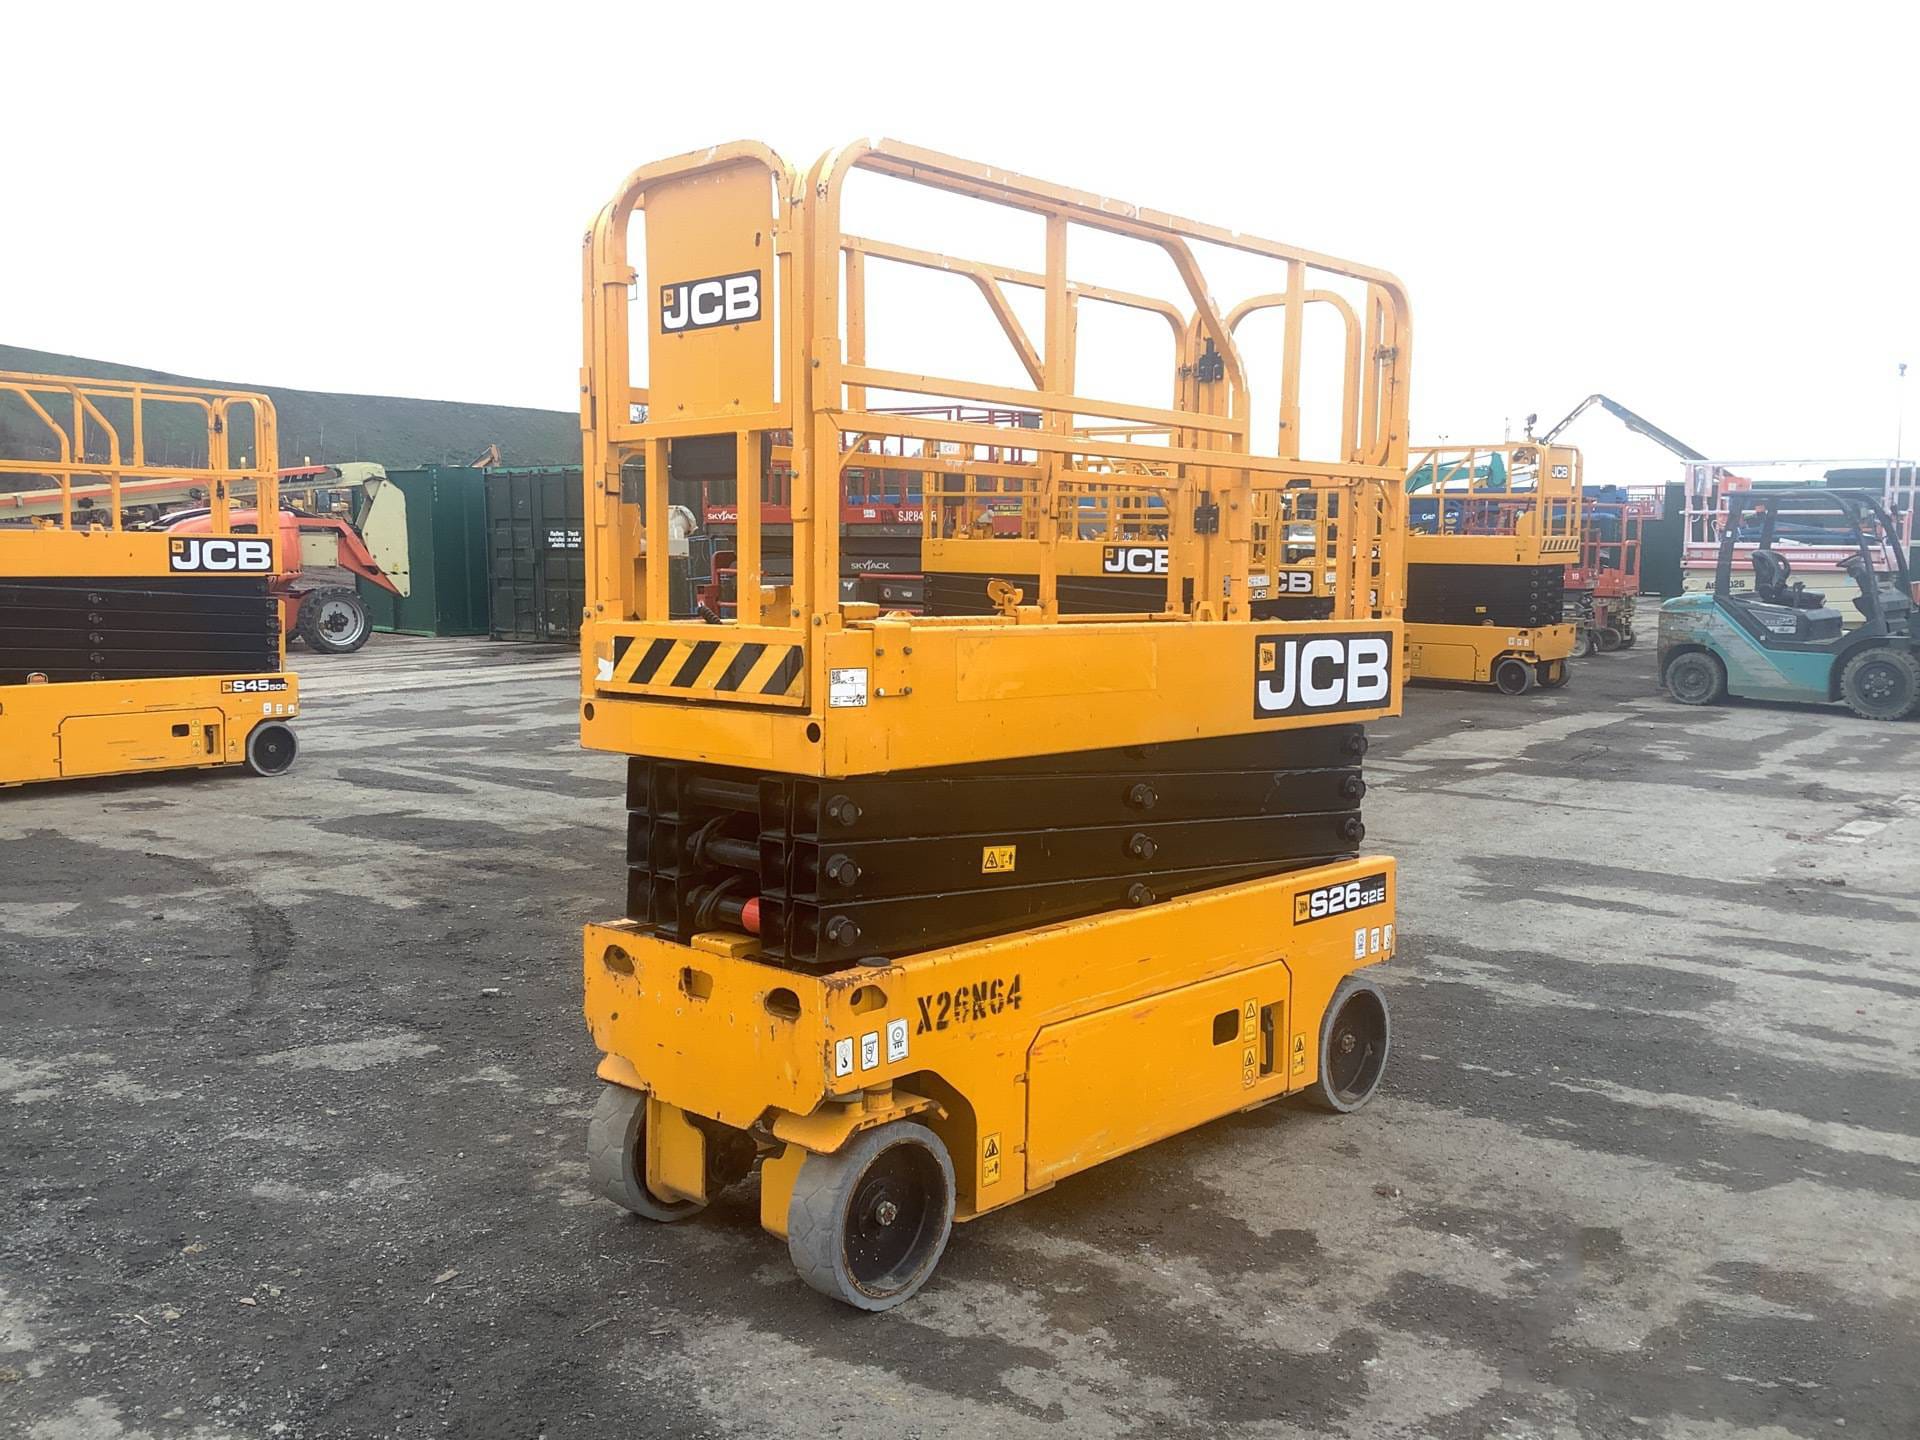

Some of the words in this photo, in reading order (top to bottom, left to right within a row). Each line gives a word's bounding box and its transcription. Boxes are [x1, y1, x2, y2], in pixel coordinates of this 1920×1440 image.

[663, 276, 759, 329] JCB
[1552, 466, 1568, 478] JCB
[707, 510, 738, 521] SKYJAC
[172, 540, 271, 570] JCB
[851, 560, 890, 570] SKYJACK
[1252, 589, 1267, 599] JCB
[1259, 639, 1389, 710] JCB
[917, 974, 1021, 1035] X26N64
